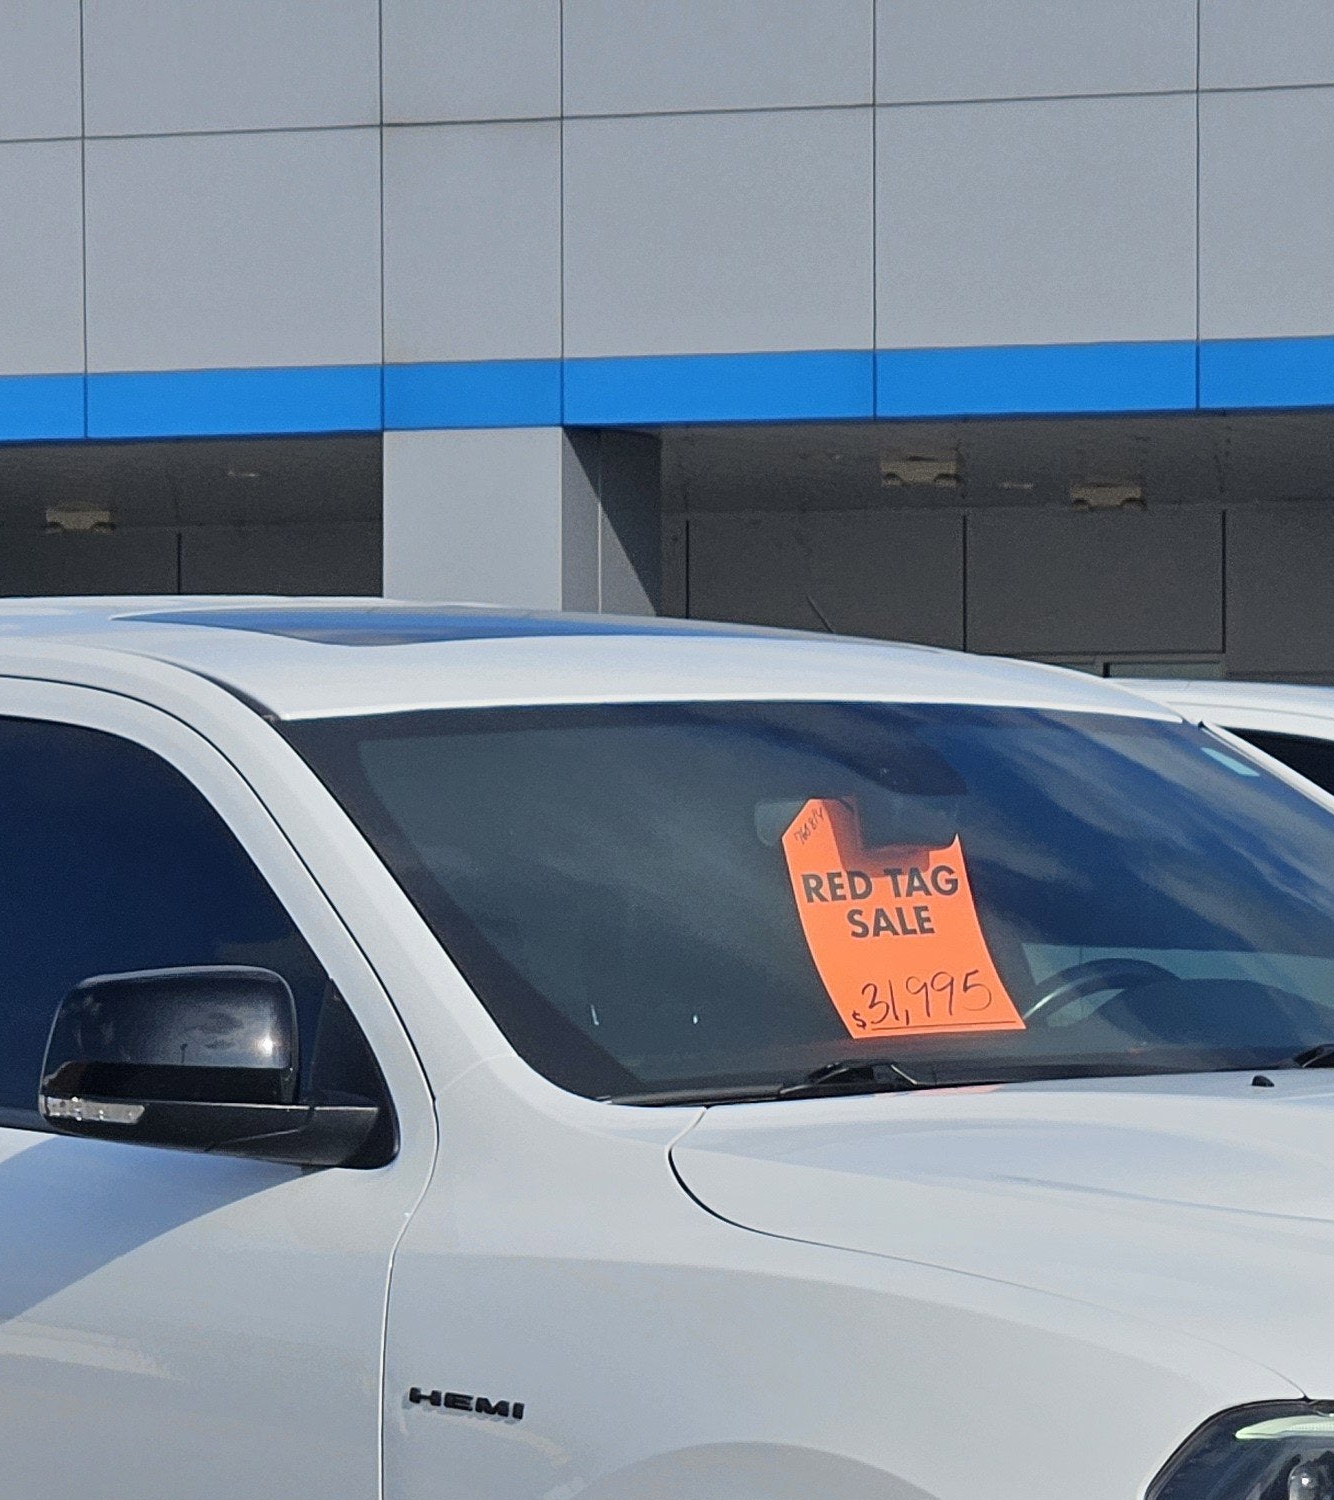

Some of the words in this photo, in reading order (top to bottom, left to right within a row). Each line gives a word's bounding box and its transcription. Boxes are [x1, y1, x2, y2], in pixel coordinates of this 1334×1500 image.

[801, 870, 873, 903] RED
[884, 865, 959, 898] TAG
[846, 906, 935, 938] SALE
[409, 1387, 525, 1420] HEMI
